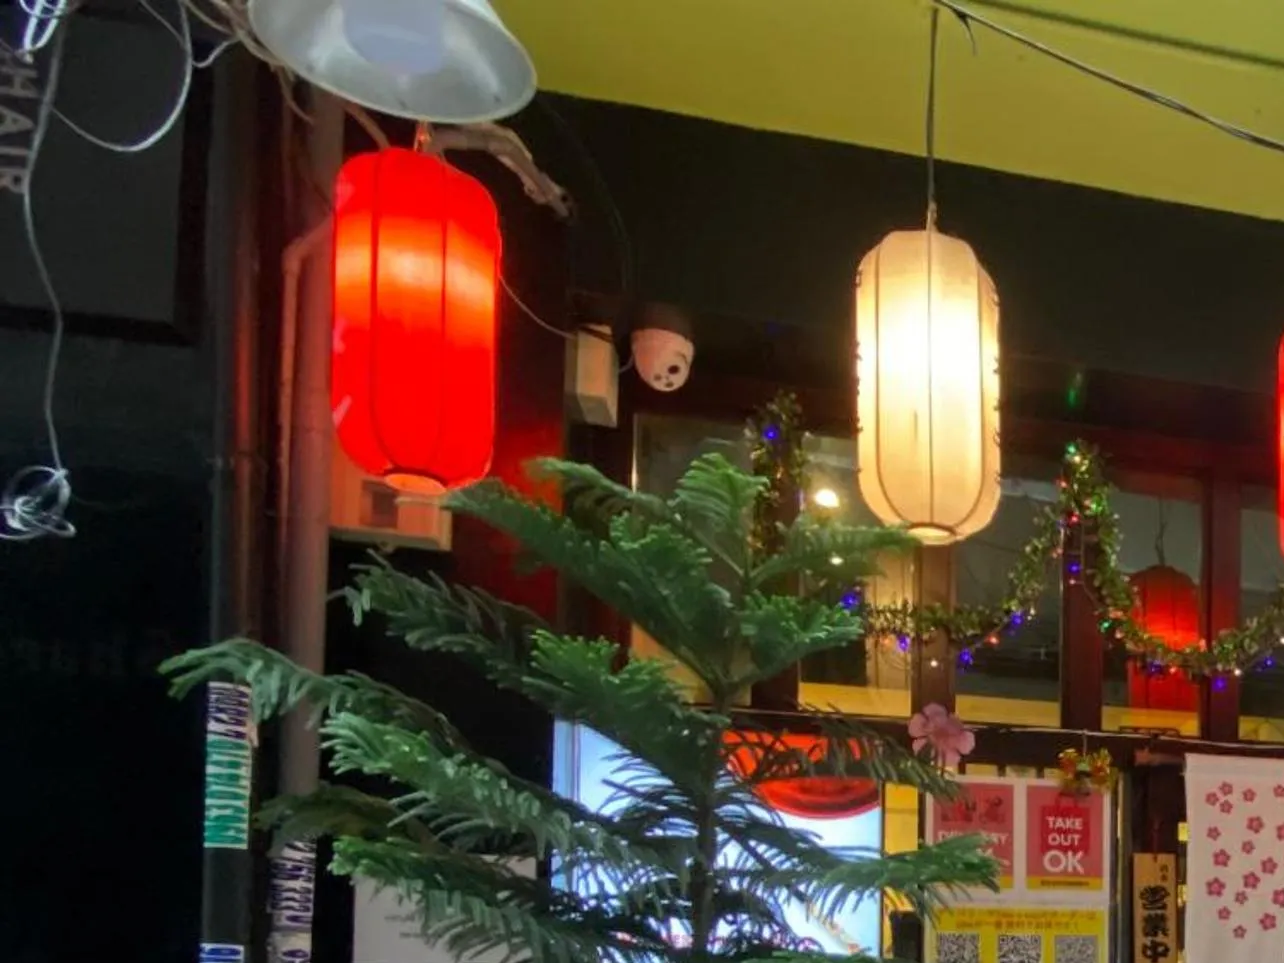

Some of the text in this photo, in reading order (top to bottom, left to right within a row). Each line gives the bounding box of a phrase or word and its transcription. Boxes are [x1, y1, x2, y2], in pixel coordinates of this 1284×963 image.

[1046, 815, 1083, 830] TAKE
[1047, 832, 1081, 847] OUT
[1042, 849, 1085, 875] OK
